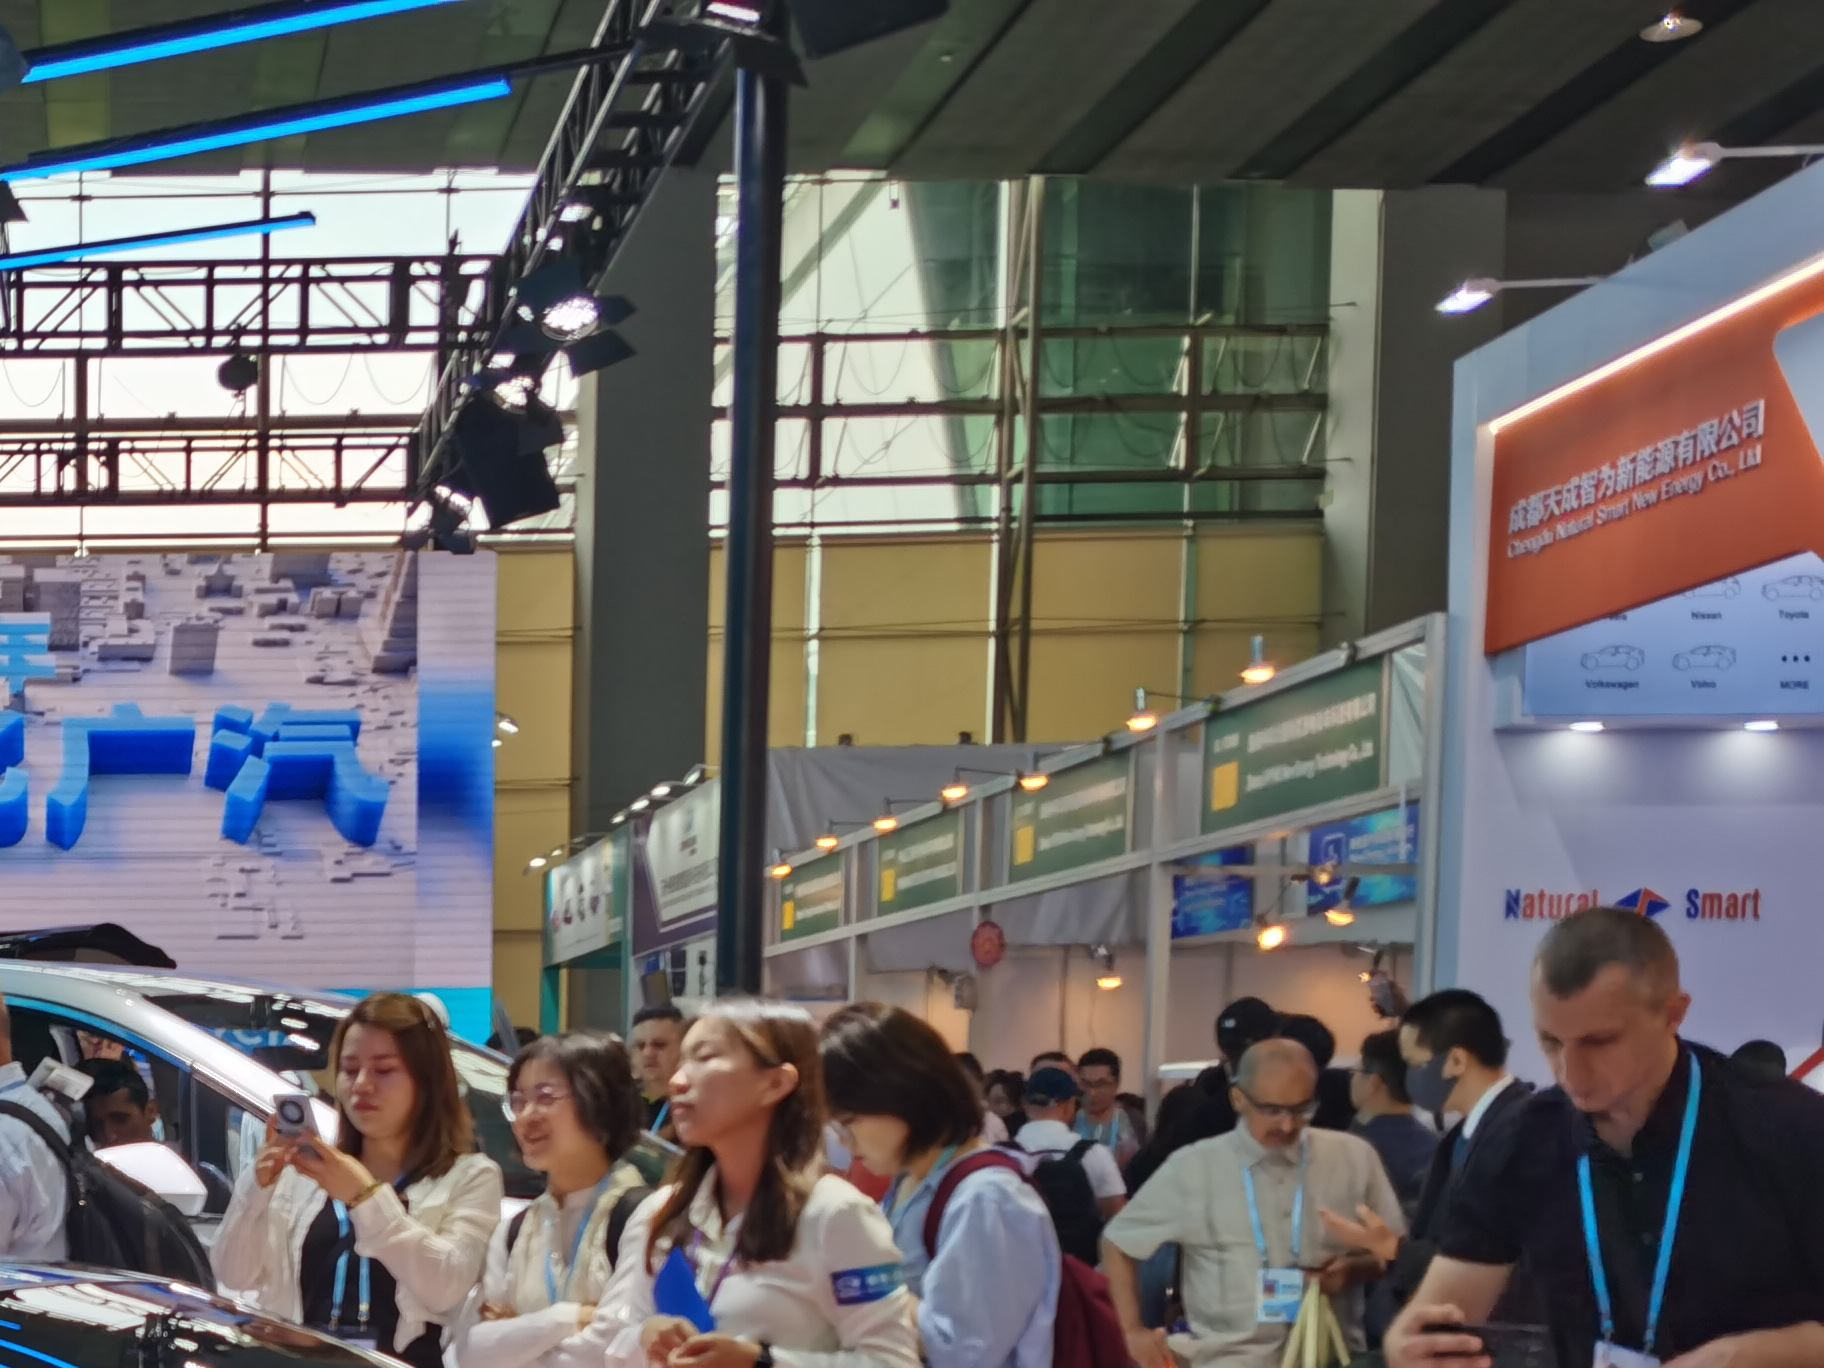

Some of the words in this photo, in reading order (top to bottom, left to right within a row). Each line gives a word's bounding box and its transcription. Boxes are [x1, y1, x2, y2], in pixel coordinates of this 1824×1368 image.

[1507, 527, 1554, 559] Chengdu
[1556, 515, 1594, 540] Natural
[1596, 498, 1631, 525] Smart
[1632, 489, 1659, 511] New
[1660, 473, 1705, 500] Energy
[1584, 679, 1640, 690] Volkswagen
[1685, 888, 1761, 921] Smart
